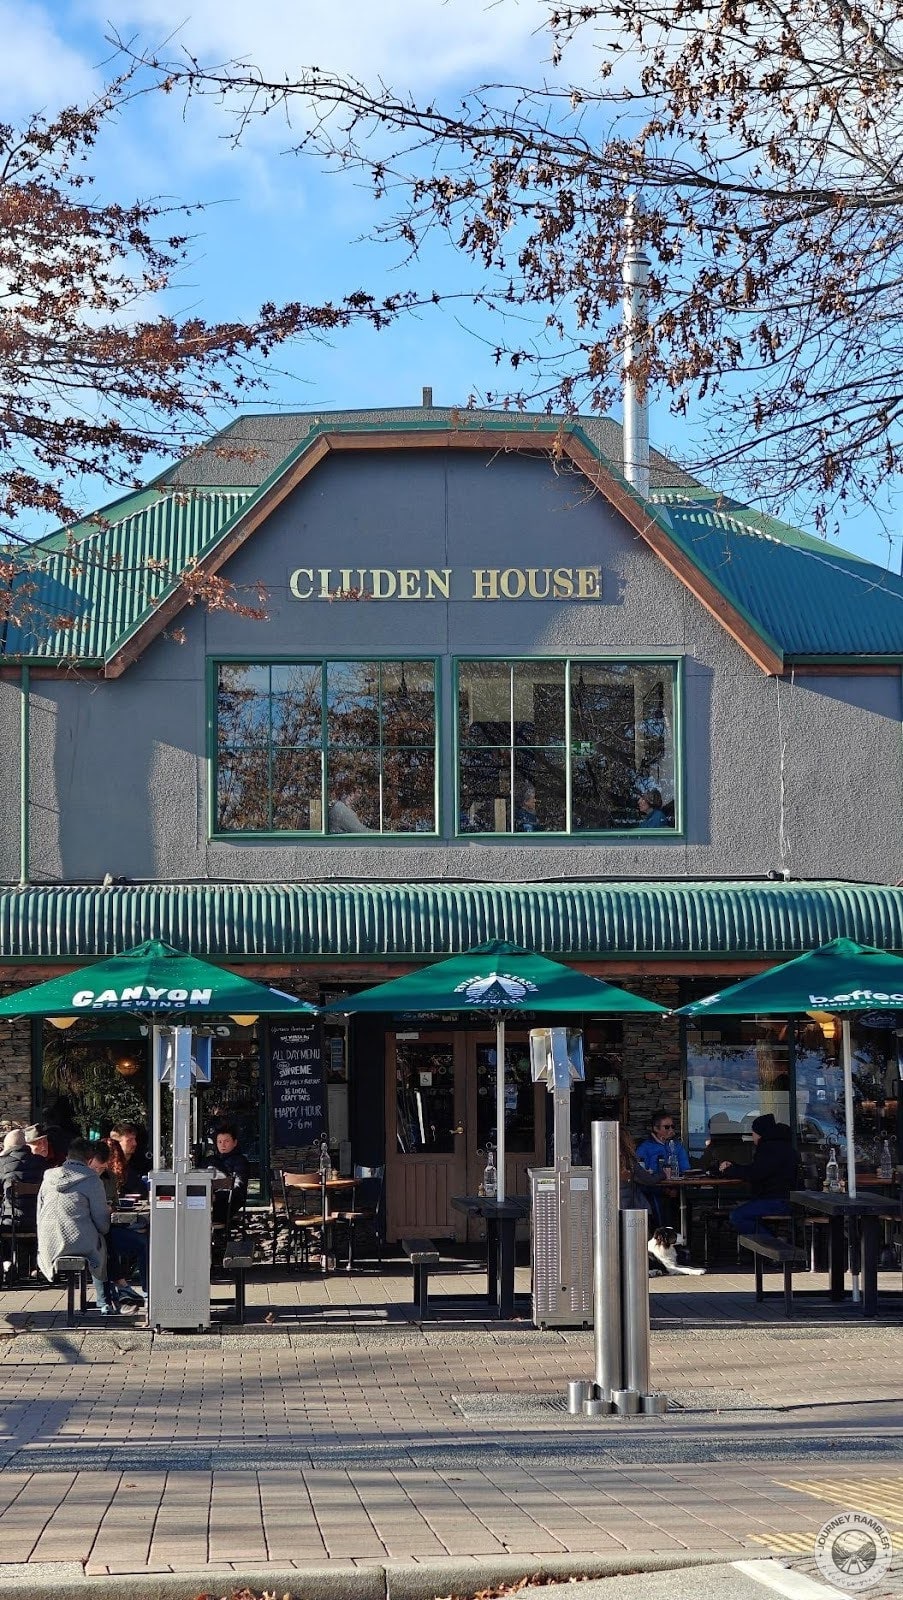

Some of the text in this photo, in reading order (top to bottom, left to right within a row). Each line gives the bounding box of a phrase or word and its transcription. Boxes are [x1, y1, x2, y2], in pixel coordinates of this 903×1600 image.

[289, 568, 600, 599] CLUDEN HOUSE
[72, 986, 212, 1007] CANYON
[272, 1048, 320, 1061] ALL DAY MENU
[291, 1087, 308, 1095] LOCAL
[274, 1104, 322, 1118] HAPPY HOUR
